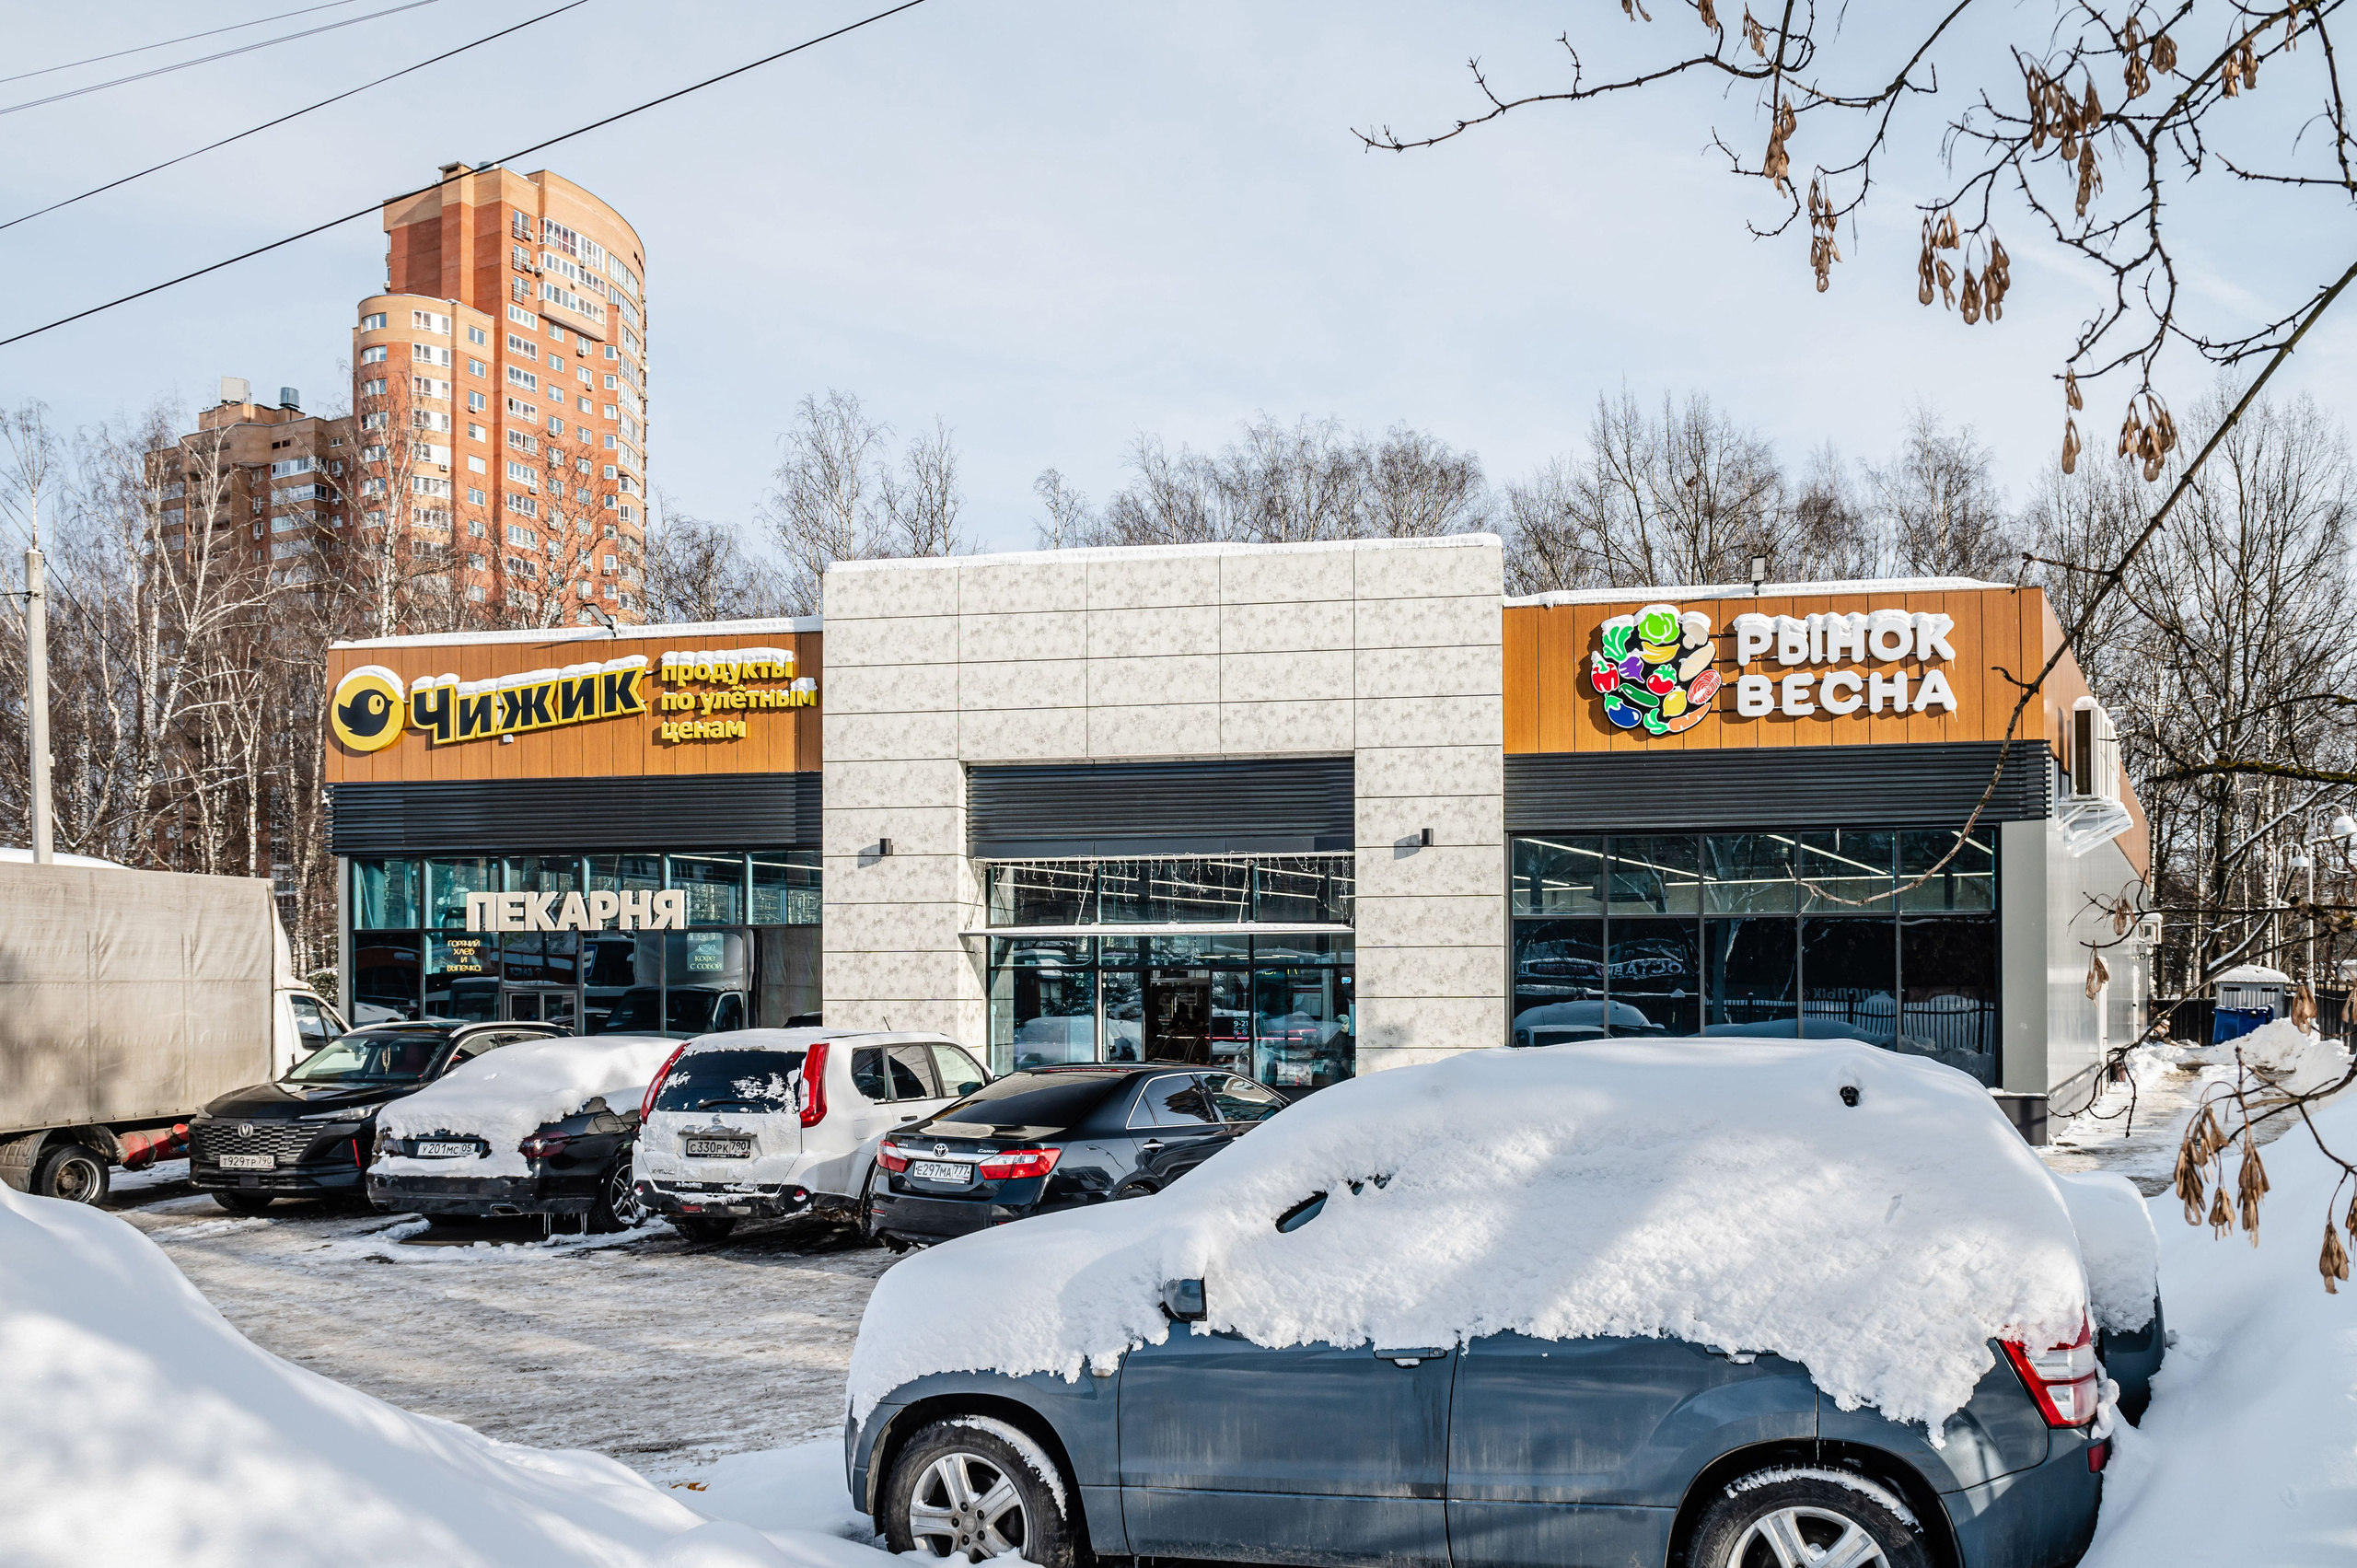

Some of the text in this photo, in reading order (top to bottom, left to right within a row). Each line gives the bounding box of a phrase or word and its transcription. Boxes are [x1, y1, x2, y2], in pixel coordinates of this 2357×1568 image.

[1737, 618, 1956, 667] РЫНОК
[661, 660, 794, 687] продукты
[661, 684, 818, 715] по улётным
[1737, 669, 1957, 717] ВЕСНА
[661, 720, 746, 743] ценам
[466, 889, 685, 932] ПЕКАРНЯ
[447, 939, 481, 947] ГОРЯЧИЙ
[453, 947, 475, 956] ХЛЕБ
[447, 964, 482, 972] ВЫПЕЧКА
[423, 1144, 472, 1155] У201МС 05
[691, 1141, 729, 1154] С330РК
[223, 1156, 256, 1167] Т929ТР
[917, 1163, 970, 1178] Е297МА 777
